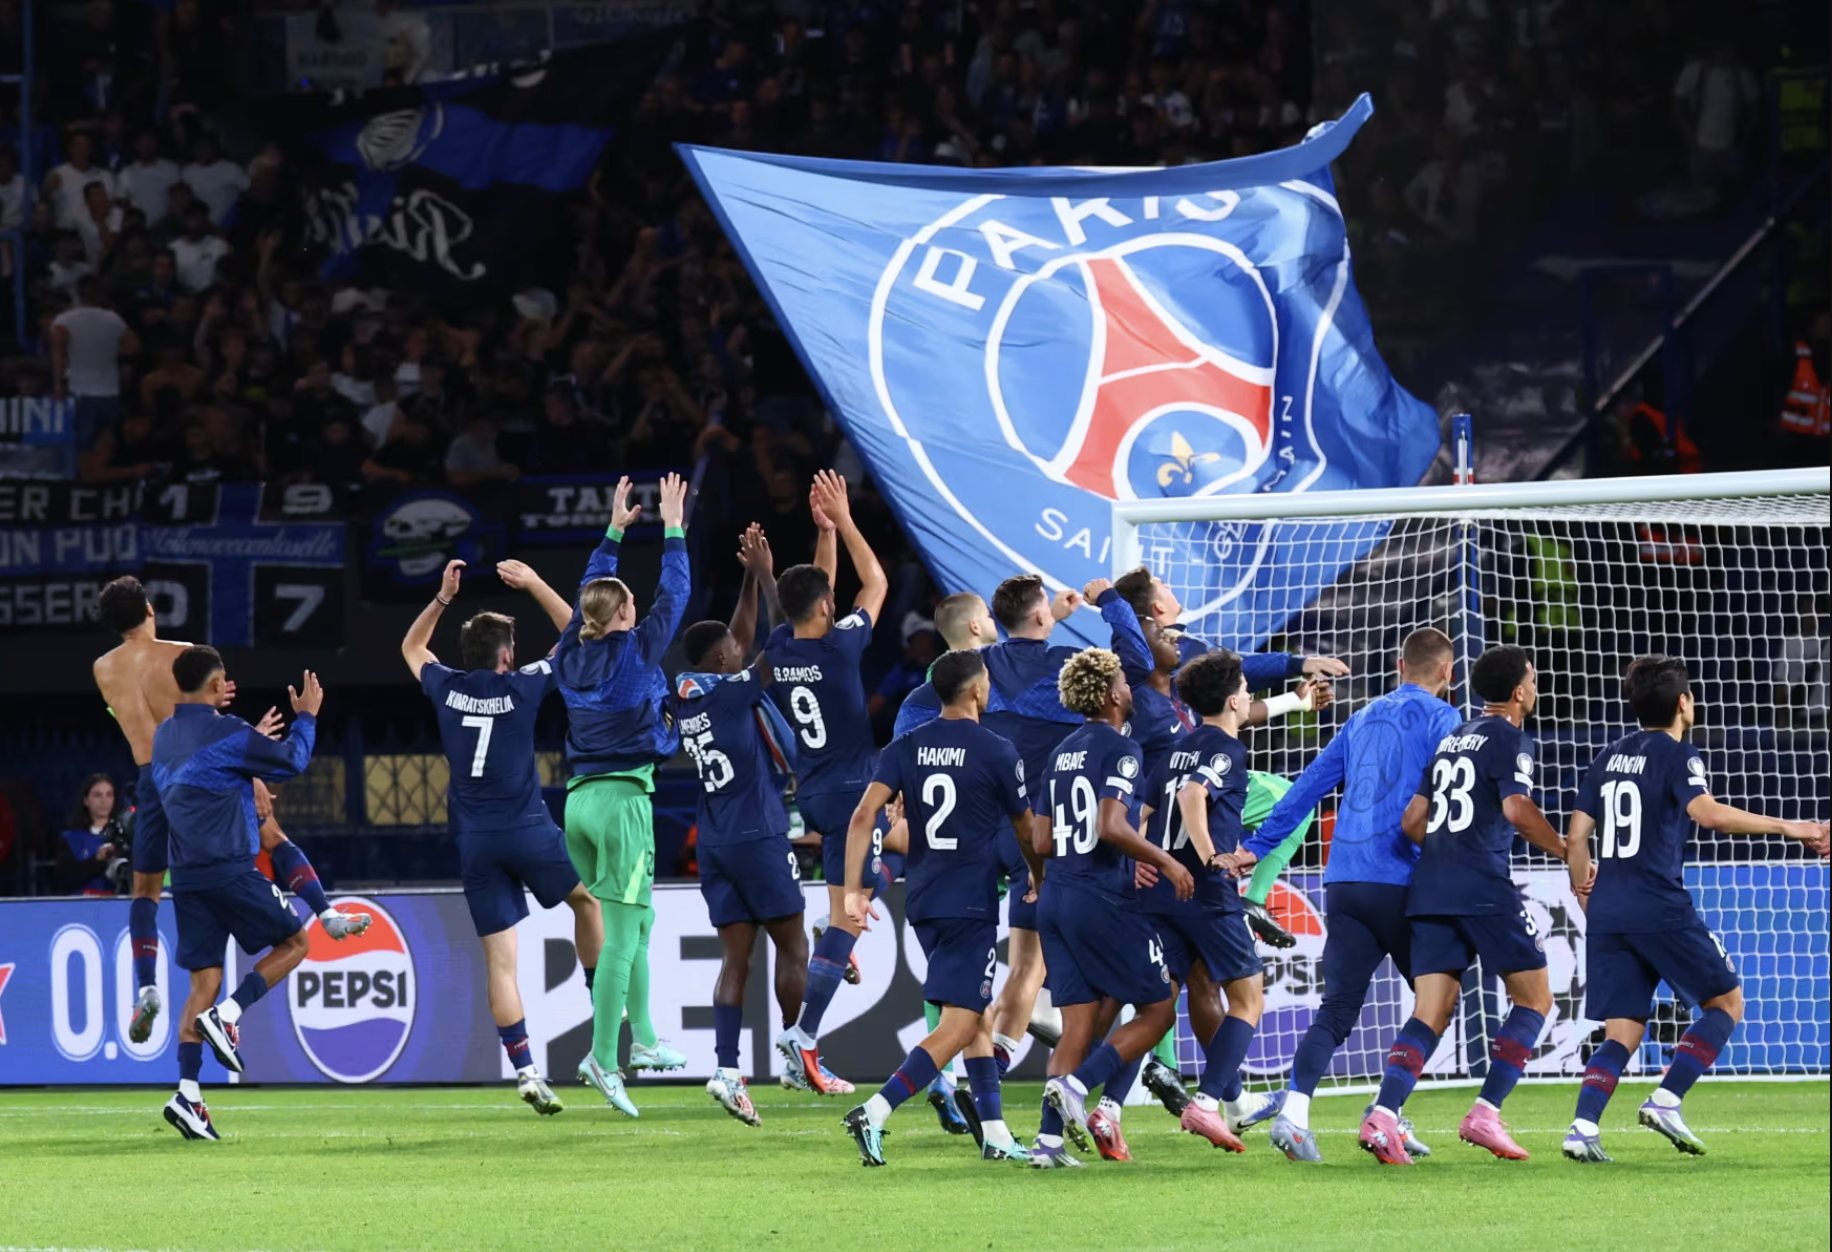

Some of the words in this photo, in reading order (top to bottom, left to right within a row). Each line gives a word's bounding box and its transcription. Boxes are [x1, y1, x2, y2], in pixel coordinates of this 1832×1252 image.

[0, 397, 65, 434] INI
[159, 484, 188, 519] 1
[282, 484, 332, 514] 9
[275, 585, 325, 632] 7
[774, 665, 823, 683] G.RAMOS
[790, 686, 827, 749] 9
[461, 715, 494, 777] 7
[917, 746, 966, 767] HAKIMI
[922, 772, 958, 851] 2
[1426, 756, 1476, 834] 33
[1049, 775, 1099, 857] 49
[1600, 779, 1642, 859] 19
[872, 828, 883, 856] 9
[984, 948, 996, 977] 2
[1149, 932, 1163, 966] 4
[1709, 931, 1727, 958] 1
[51, 923, 171, 1062] 0.0
[297, 969, 407, 1008] PEPSI
